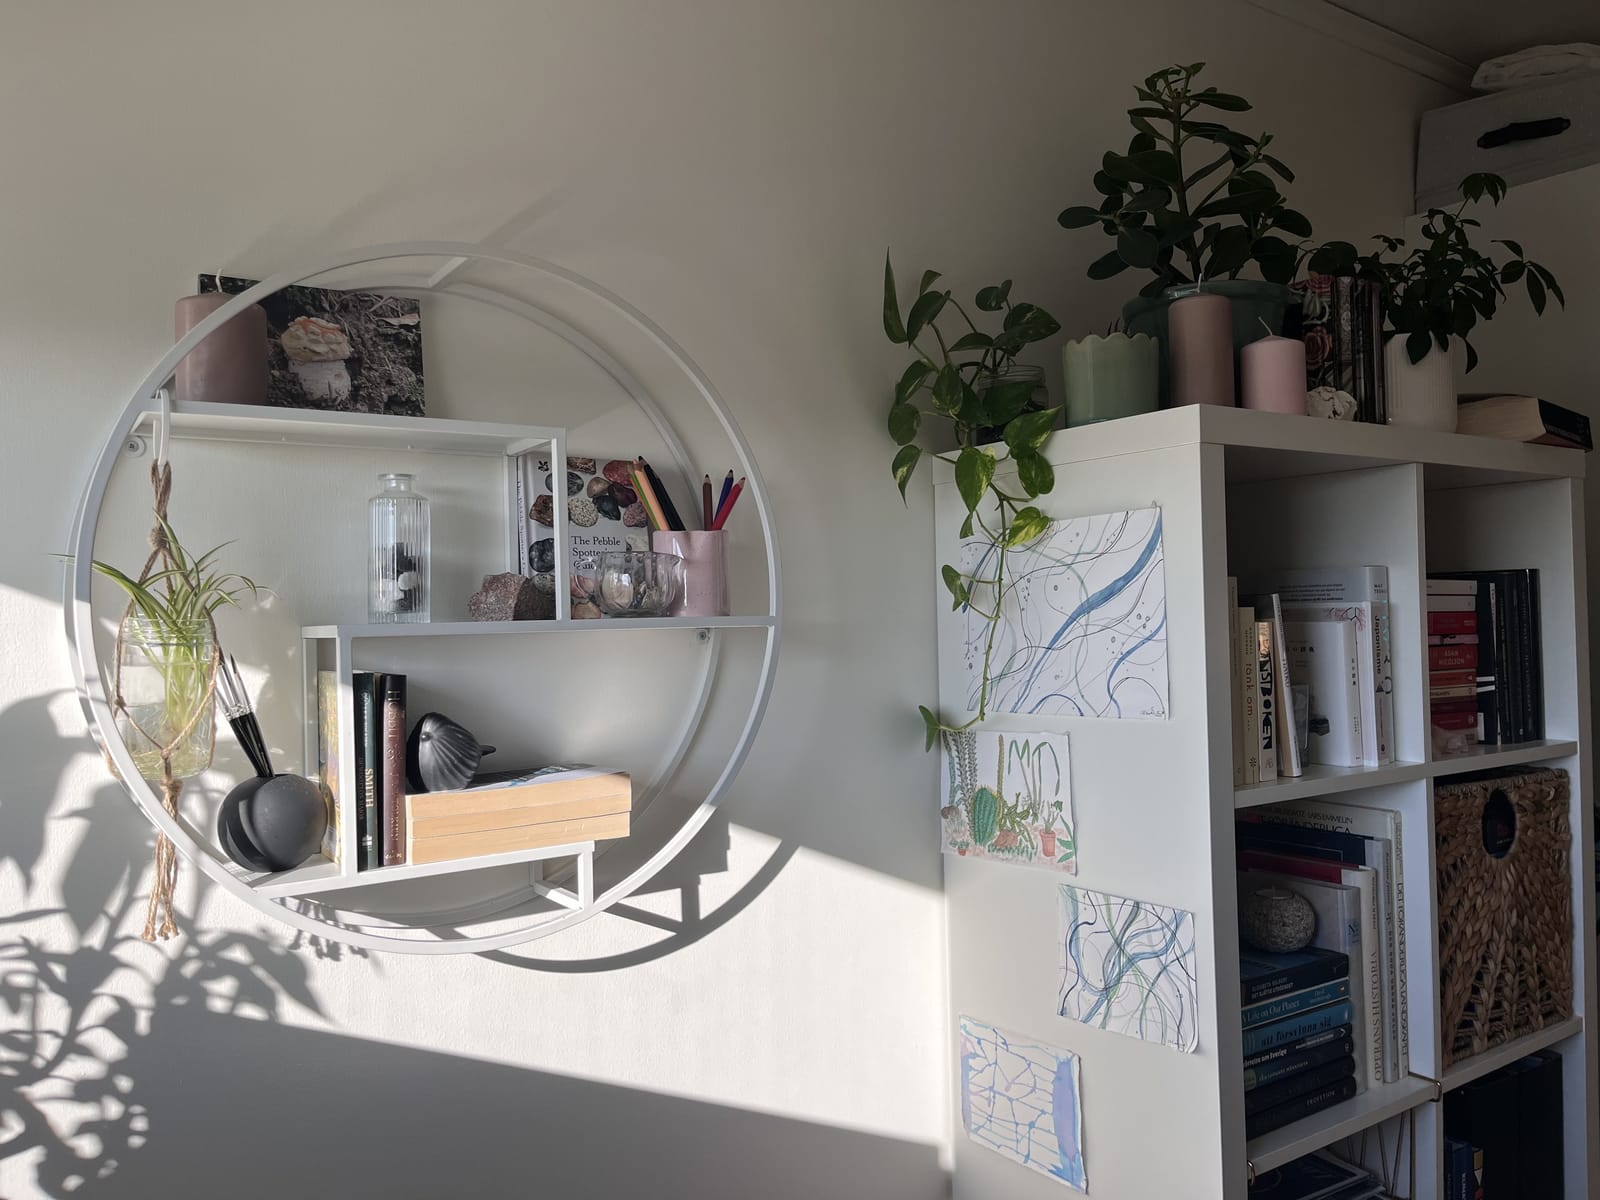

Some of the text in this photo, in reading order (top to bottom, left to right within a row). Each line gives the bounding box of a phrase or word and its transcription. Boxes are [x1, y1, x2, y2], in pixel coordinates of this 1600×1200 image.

[571, 535, 621, 546] The Pebble
[572, 547, 611, 560] Spotte'
[386, 689, 401, 739] HOBBIT
[364, 767, 375, 808] SMITH
[1281, 996, 1301, 1011] Planet
[1370, 950, 1383, 1081] OPERANS HISTORIA
